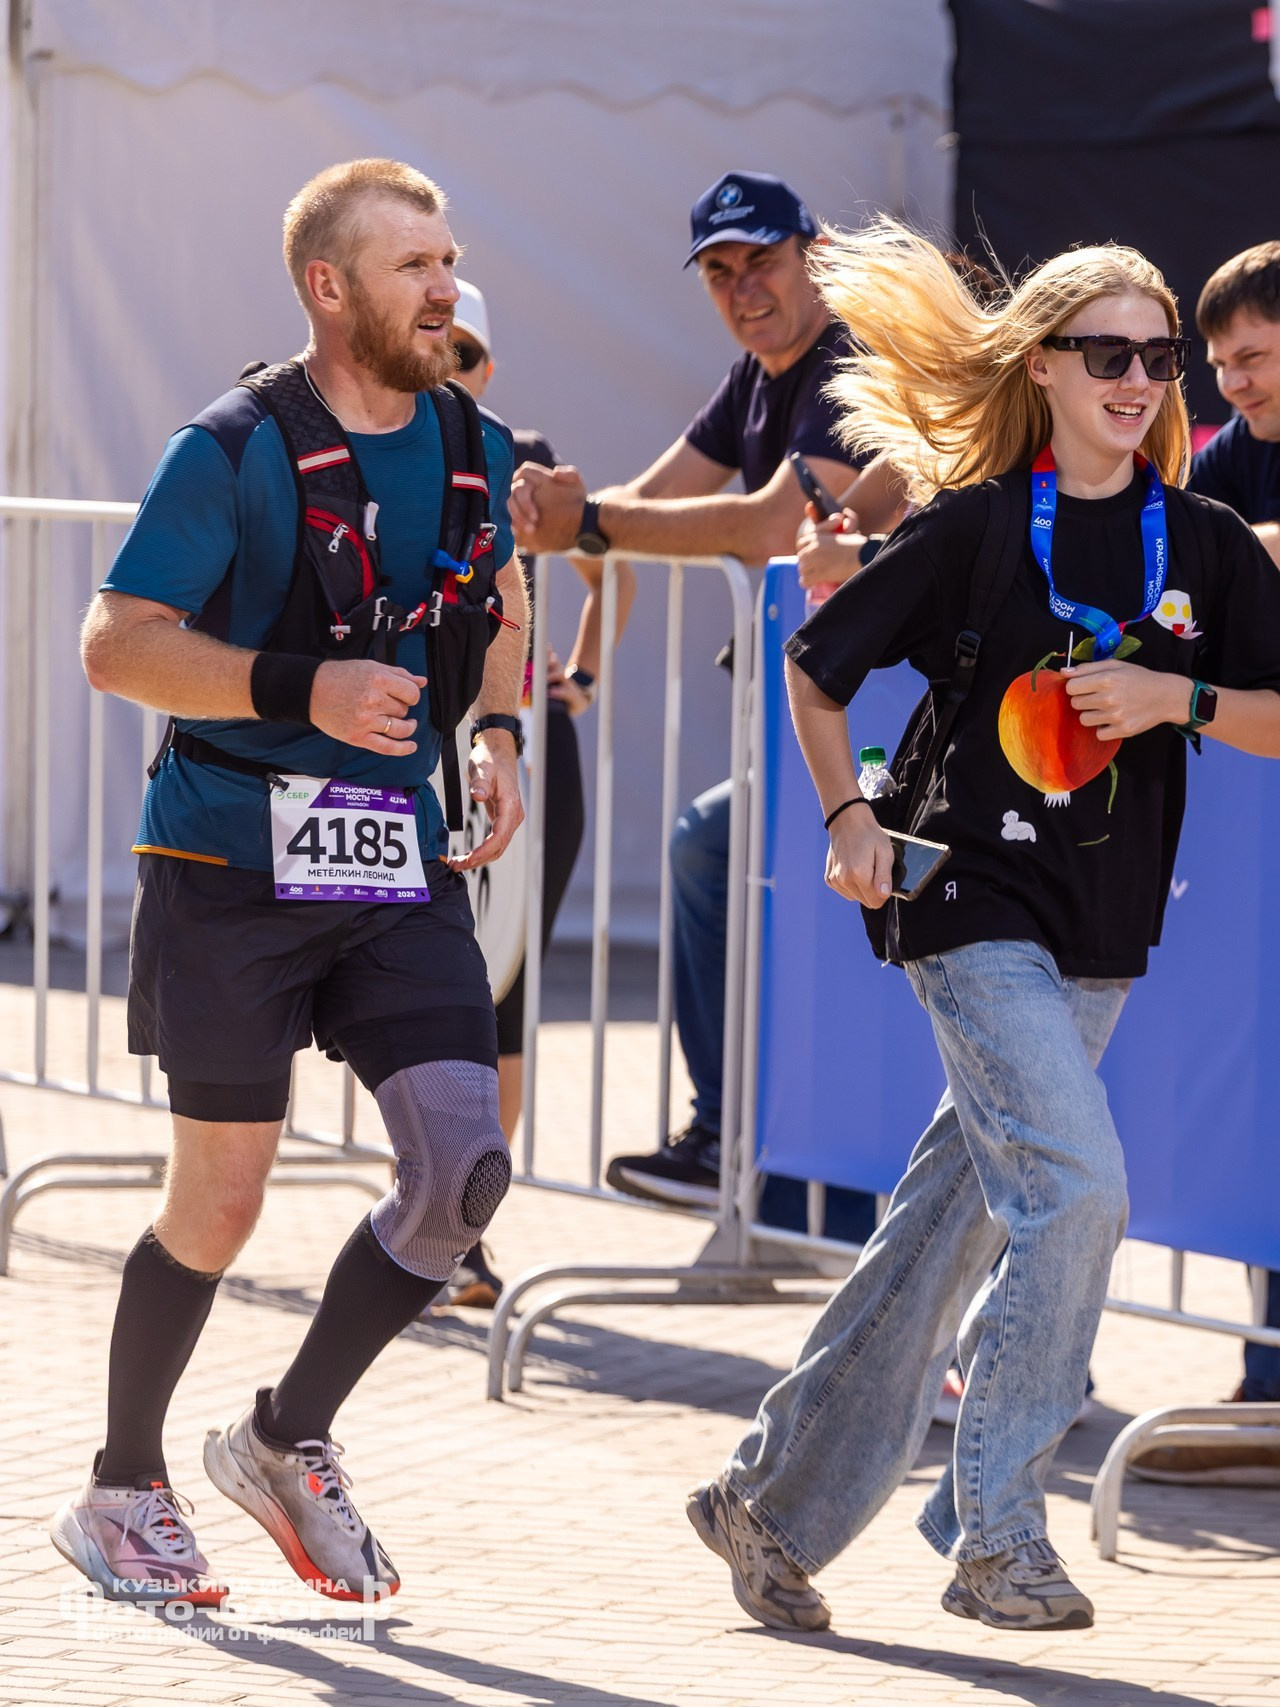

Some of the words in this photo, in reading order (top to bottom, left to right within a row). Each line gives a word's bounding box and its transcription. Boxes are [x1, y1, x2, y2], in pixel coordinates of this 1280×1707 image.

[286, 792, 309, 800] СБЕР
[329, 786, 382, 797] КРАСНОЯРСКИЕ
[345, 793, 371, 802] МОСТЫ
[286, 816, 408, 869] 4185
[307, 867, 361, 878] МЕТЁЛКИН
[362, 871, 396, 882] ЛЕОНИД
